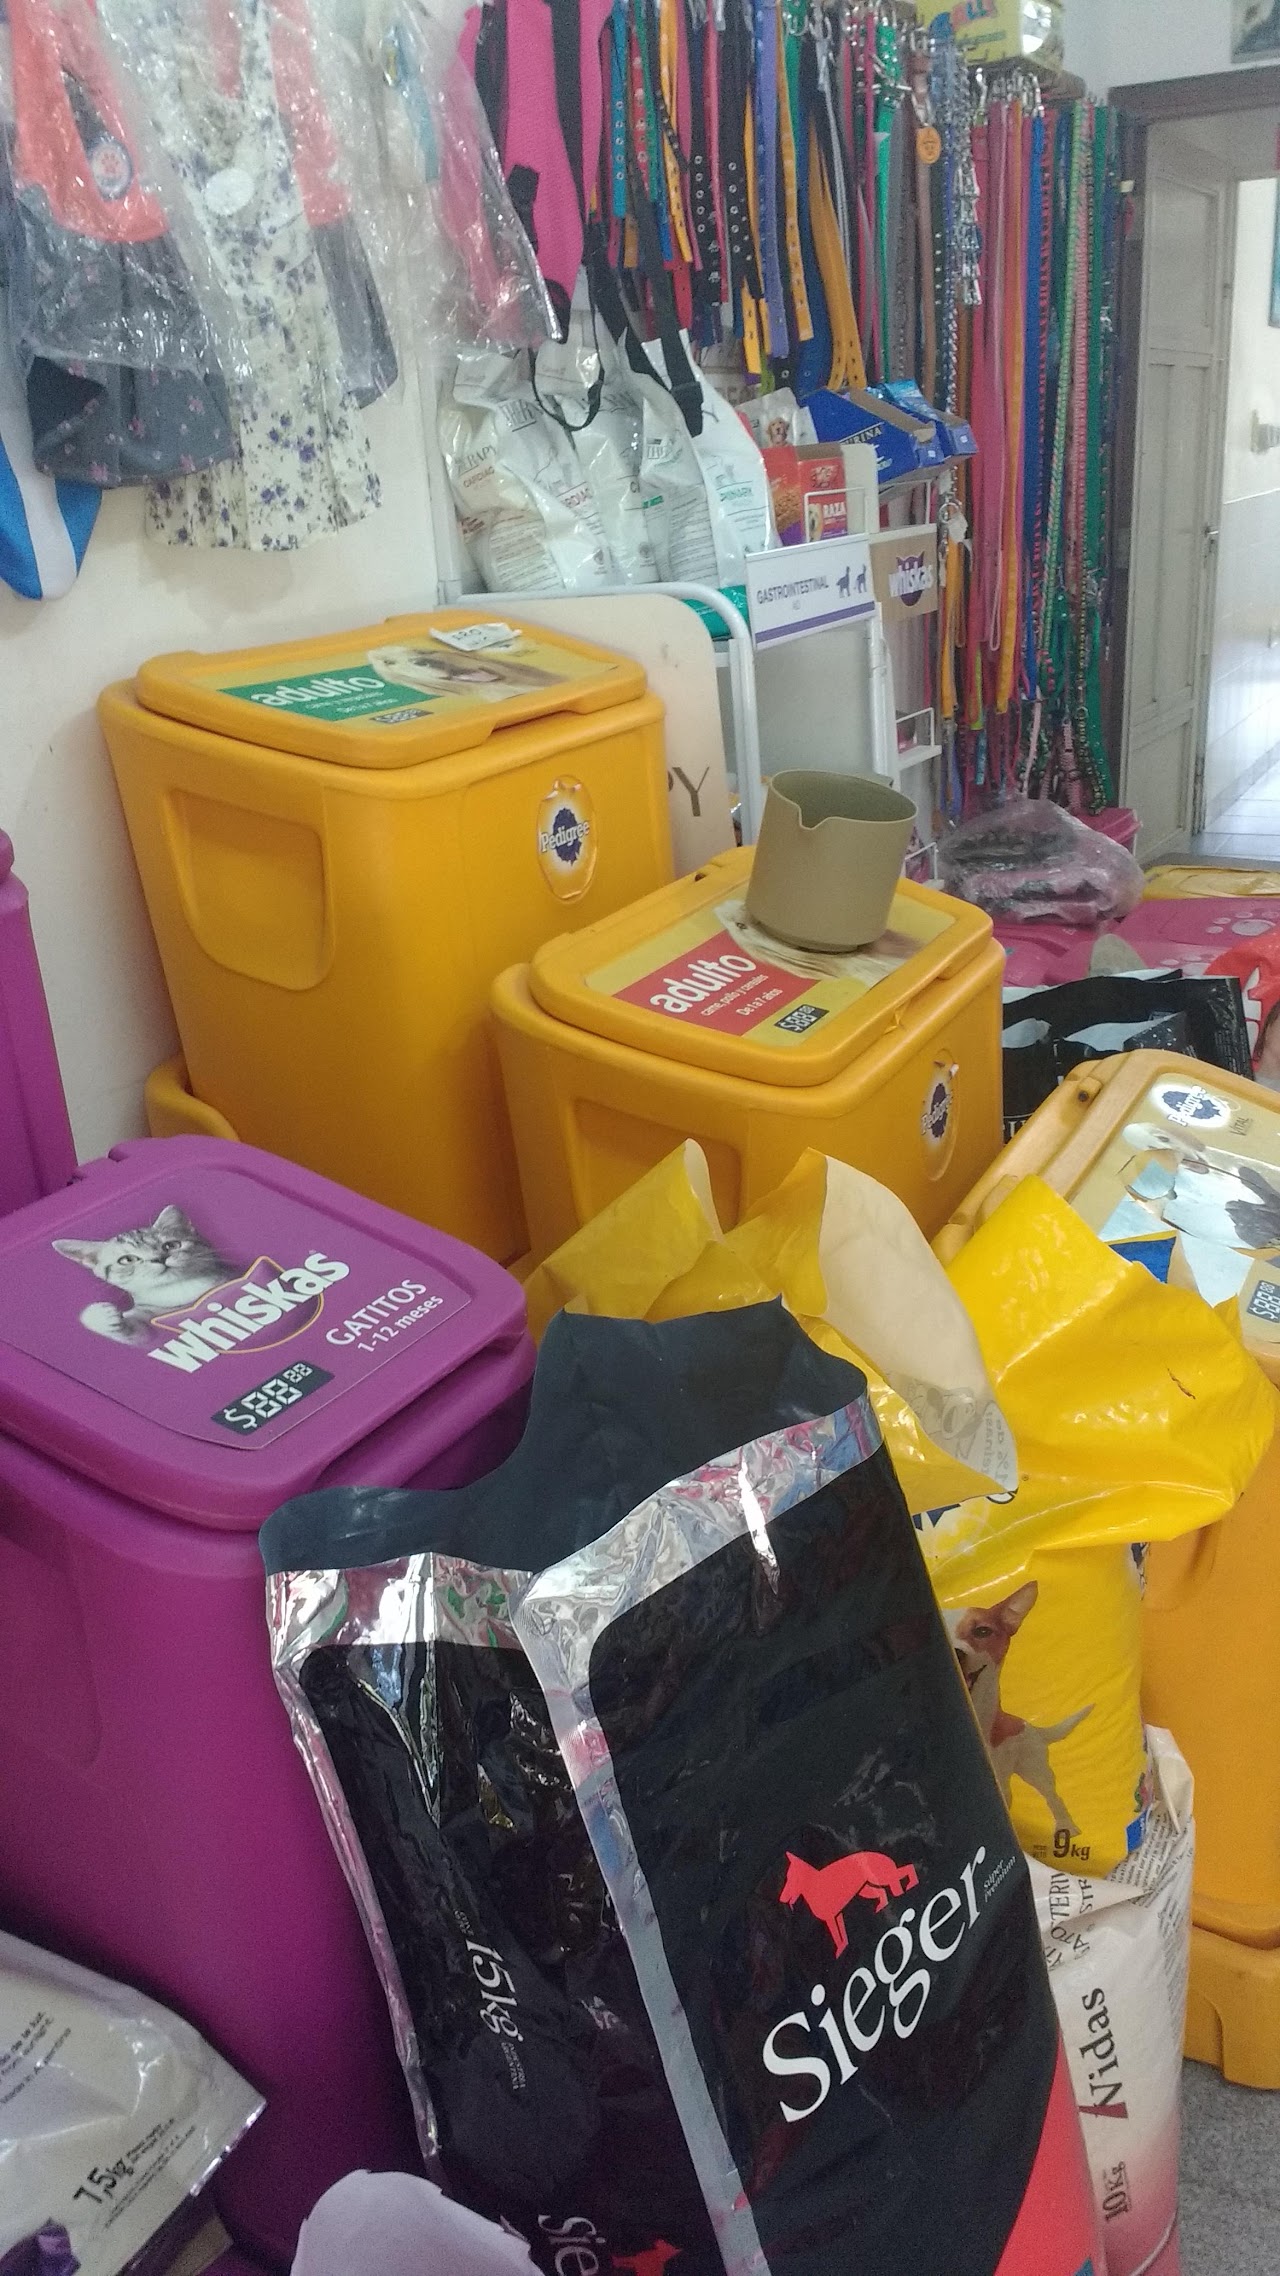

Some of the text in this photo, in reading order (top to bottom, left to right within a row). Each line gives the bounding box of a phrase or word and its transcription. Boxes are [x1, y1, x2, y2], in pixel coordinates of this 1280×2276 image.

[757, 576, 829, 604] GASTROINTESTINAL
[888, 561, 933, 598] whiskas
[251, 676, 386, 706] adulto
[539, 820, 590, 853] Pedigree
[650, 955, 757, 1013] adulto
[1167, 1085, 1207, 1128] Pedigree
[148, 1252, 350, 1373] whiskas
[325, 1279, 427, 1346] GATITOS
[358, 1295, 444, 1352] 1-12 meses
[465, 1939, 524, 2042] 15kg
[762, 1846, 986, 2123] Sieger
